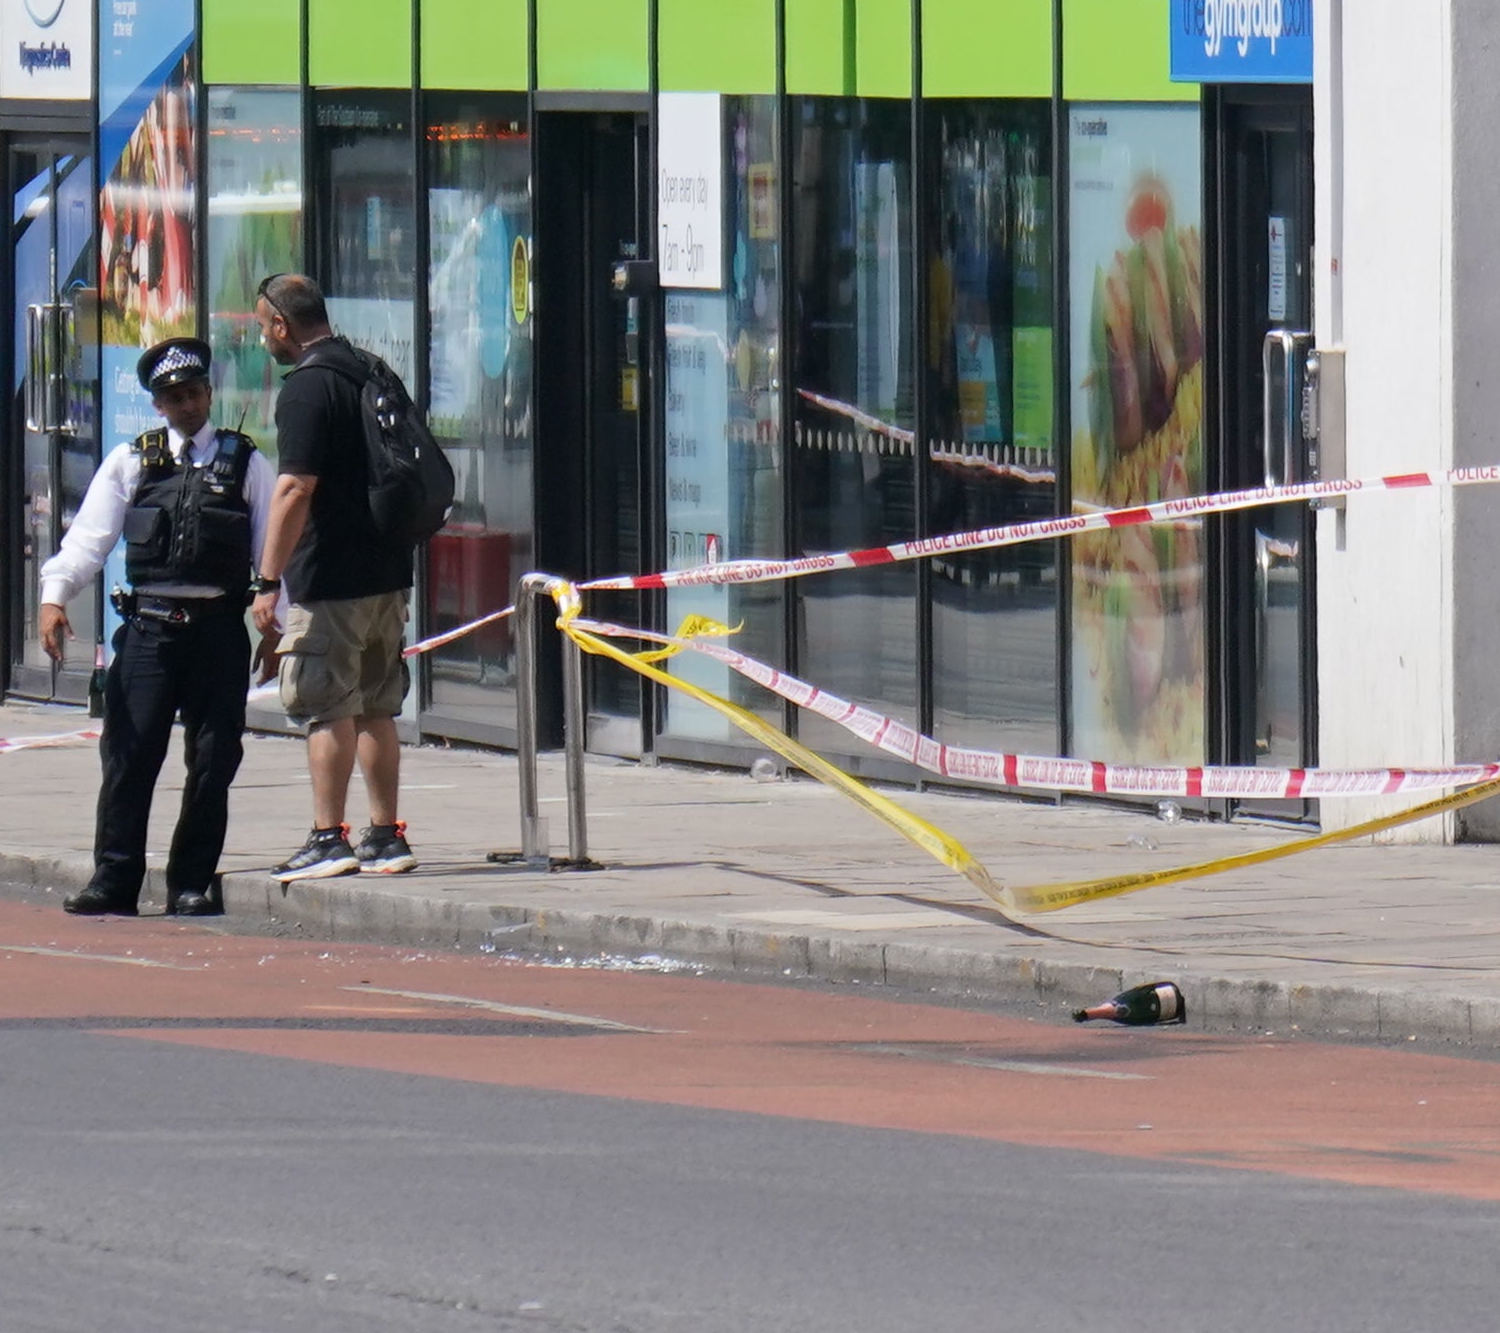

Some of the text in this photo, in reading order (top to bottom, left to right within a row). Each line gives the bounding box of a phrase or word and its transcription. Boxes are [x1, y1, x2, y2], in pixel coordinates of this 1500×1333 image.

[662, 169, 708, 211] Open every day
[662, 223, 705, 274] 7am 9pm
[904, 533, 952, 557] POLICE
